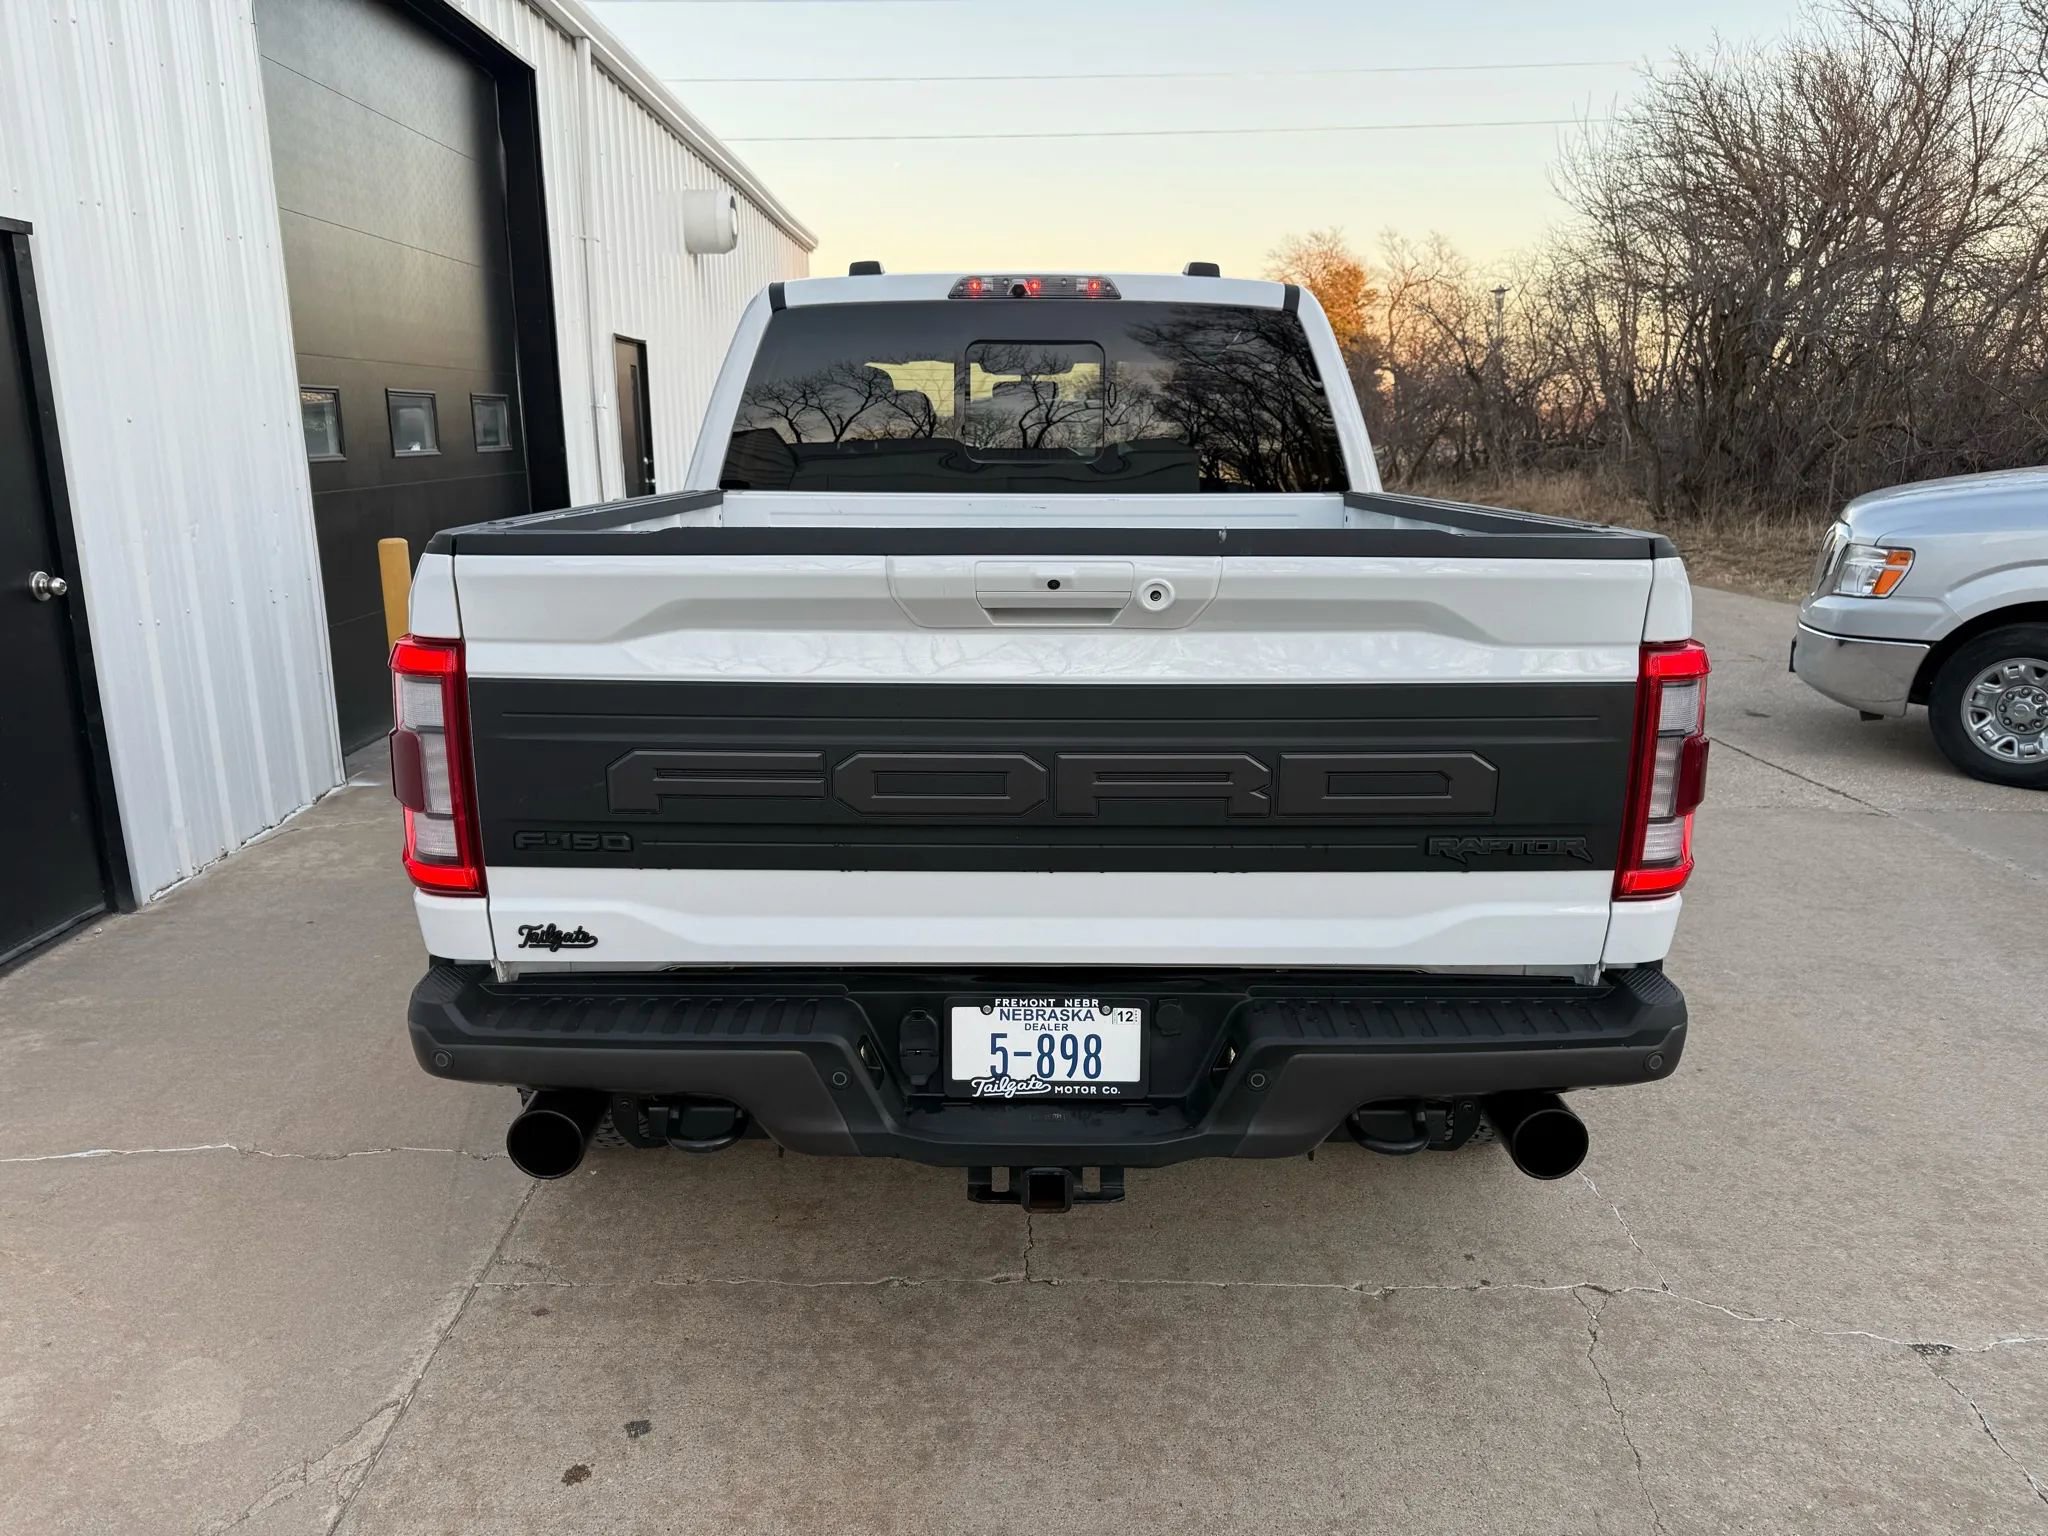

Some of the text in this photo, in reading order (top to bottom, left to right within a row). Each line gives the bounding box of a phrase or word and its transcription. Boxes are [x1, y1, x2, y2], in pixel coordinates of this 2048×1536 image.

[606, 750, 1499, 818] FORD
[1427, 835, 1593, 864] RAPTOR
[518, 923, 599, 953] Tailgate
[995, 998, 1099, 1008] FREMONT NEBR
[1000, 1008, 1095, 1022] NEBRASKA
[1024, 1022, 1069, 1032] DEALER
[1117, 1010, 1133, 1022] 12
[990, 1032, 1102, 1080] 5-898
[971, 1074, 1051, 1098] Tailgate
[1054, 1085, 1097, 1095] MOTOR
